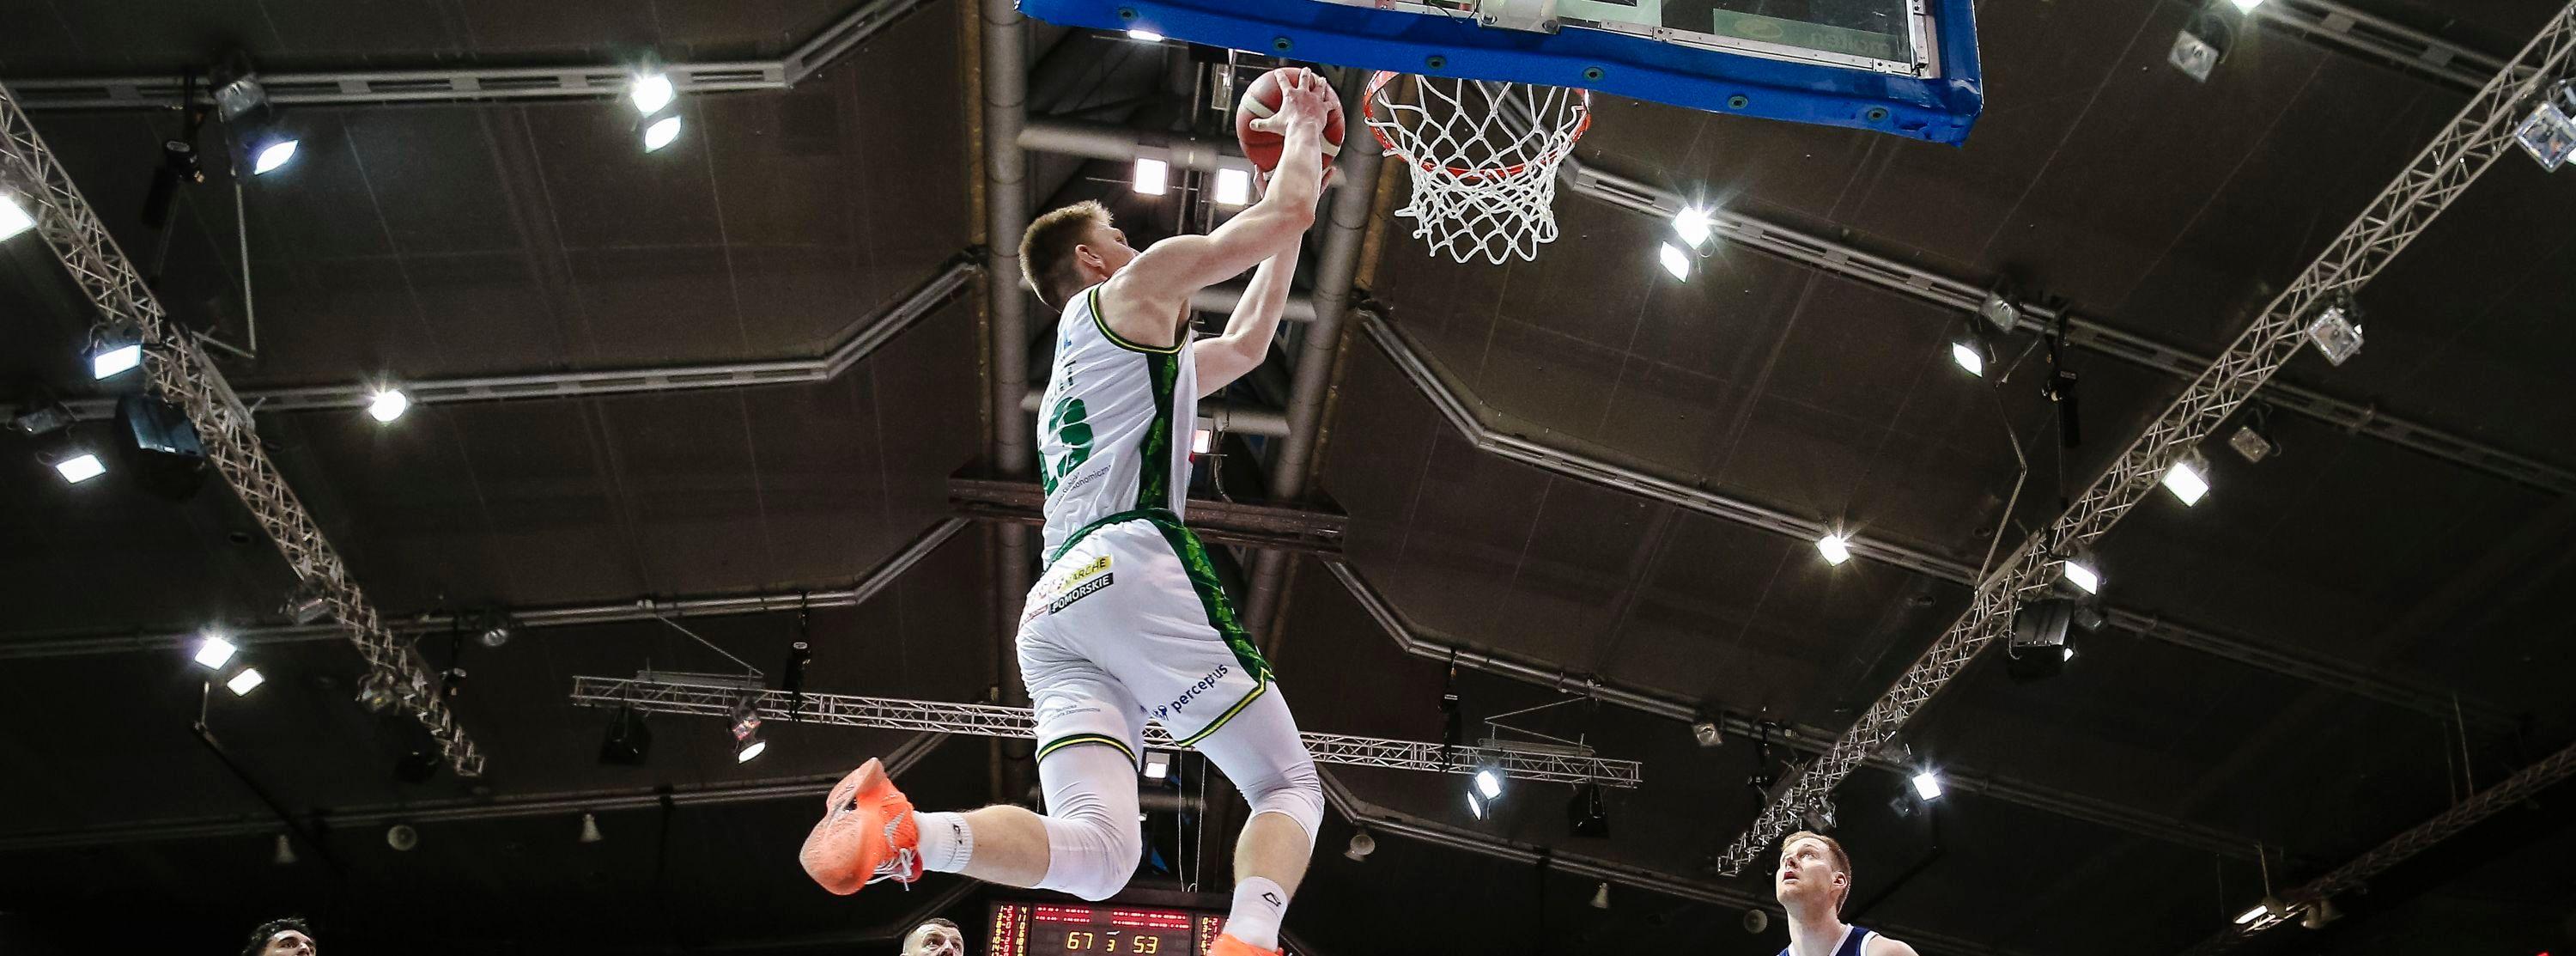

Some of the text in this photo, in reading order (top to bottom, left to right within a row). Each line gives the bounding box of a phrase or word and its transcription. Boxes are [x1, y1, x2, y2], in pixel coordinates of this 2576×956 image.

[1051, 575, 1110, 612] POMORSKIE
[1066, 931, 1094, 950] 67
[1106, 939, 1116, 952] 3
[1133, 935, 1159, 954] 53
